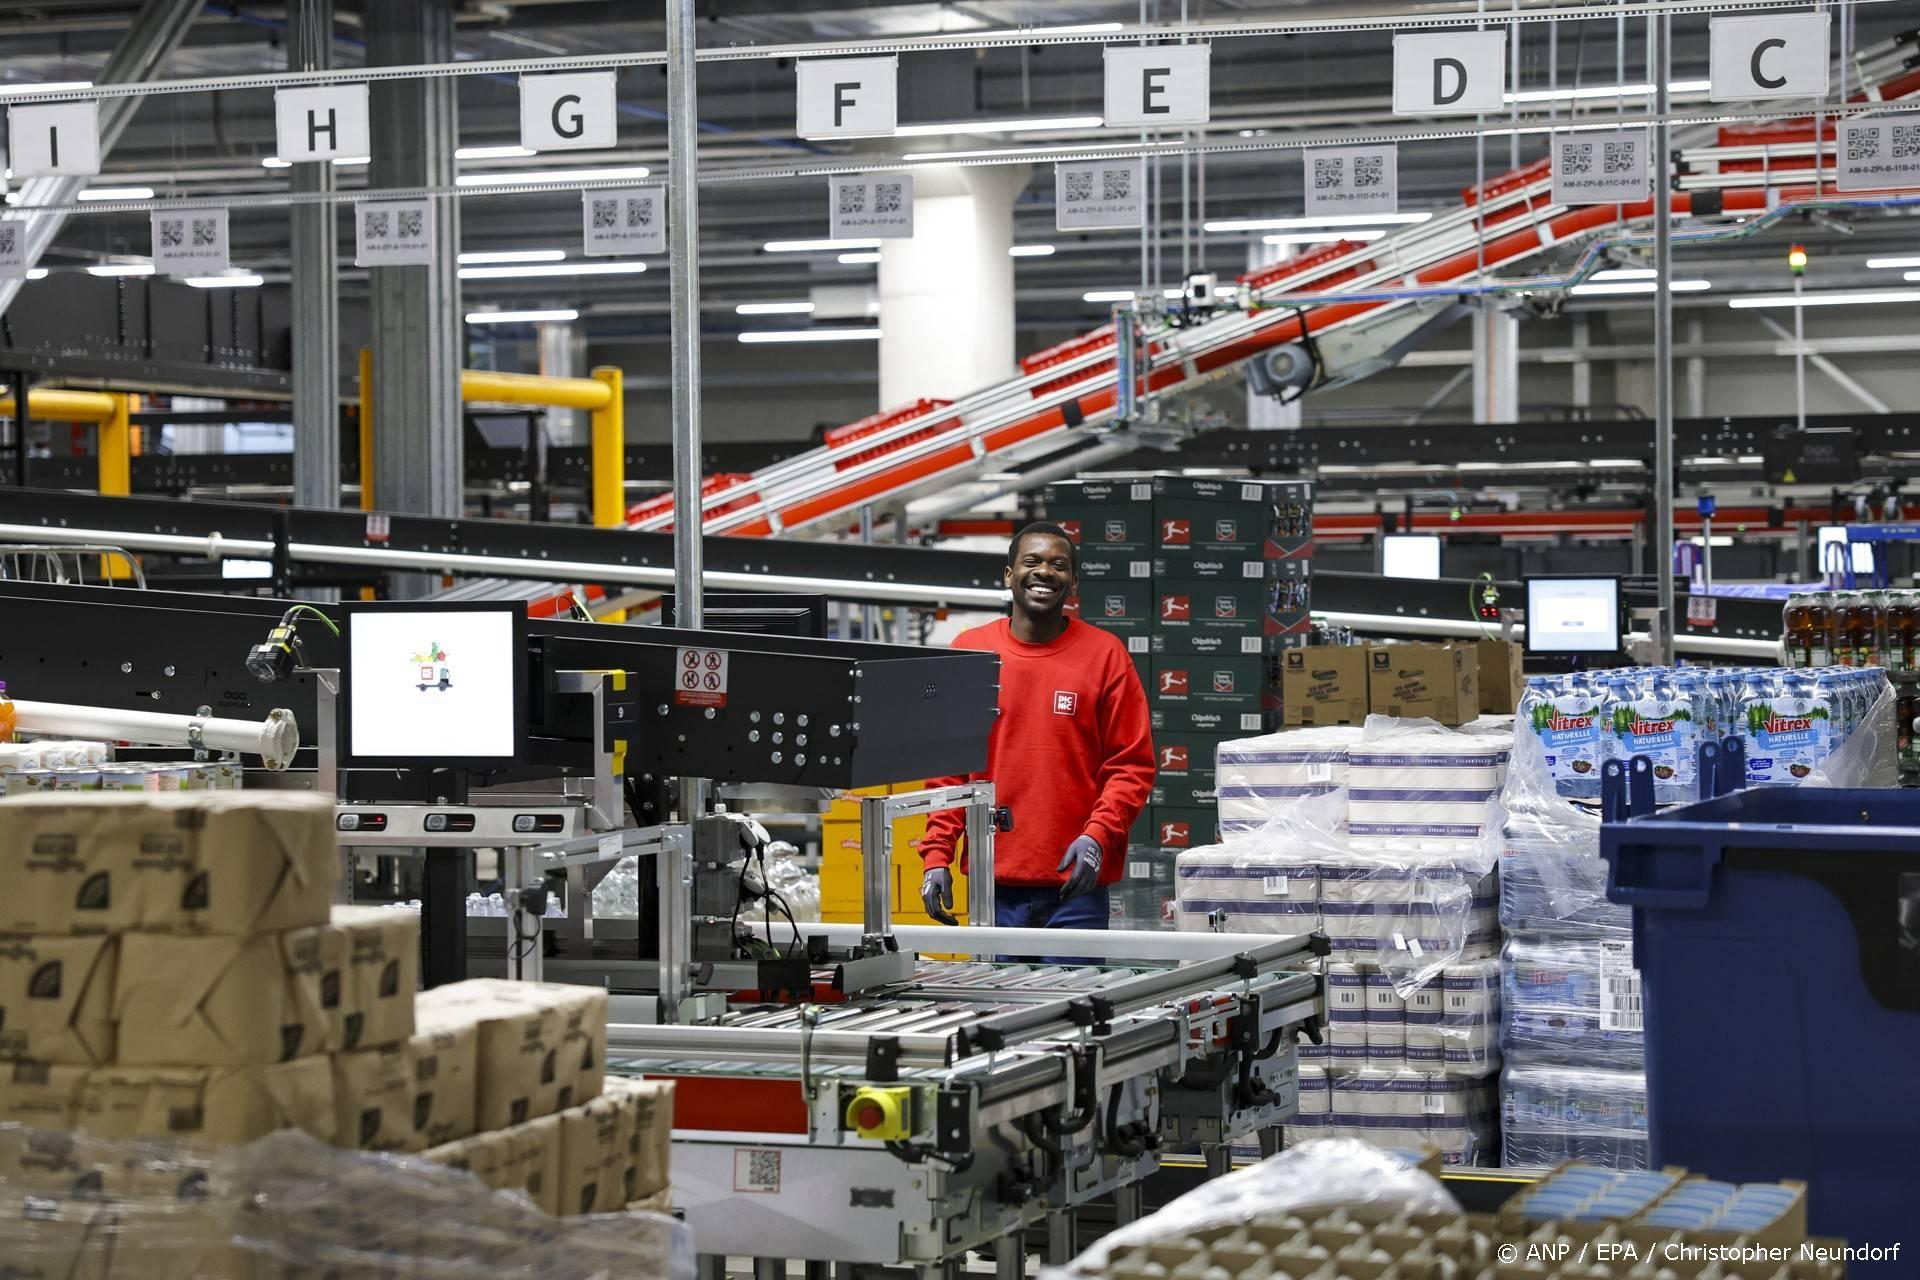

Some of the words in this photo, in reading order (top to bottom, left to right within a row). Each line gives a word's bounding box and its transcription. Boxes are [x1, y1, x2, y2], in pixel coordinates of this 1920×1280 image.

[1433, 57, 1467, 106] D
[1750, 38, 1787, 89] C
[834, 82, 861, 127] F
[1143, 68, 1171, 114] E
[307, 108, 337, 152] H
[551, 94, 584, 139] G
[50, 126, 58, 167] I
[618, 706, 624, 718] 9
[1547, 707, 1594, 732] Vitrex
[1628, 712, 1675, 737] Vitrex
[1762, 710, 1812, 735] Vitrex
